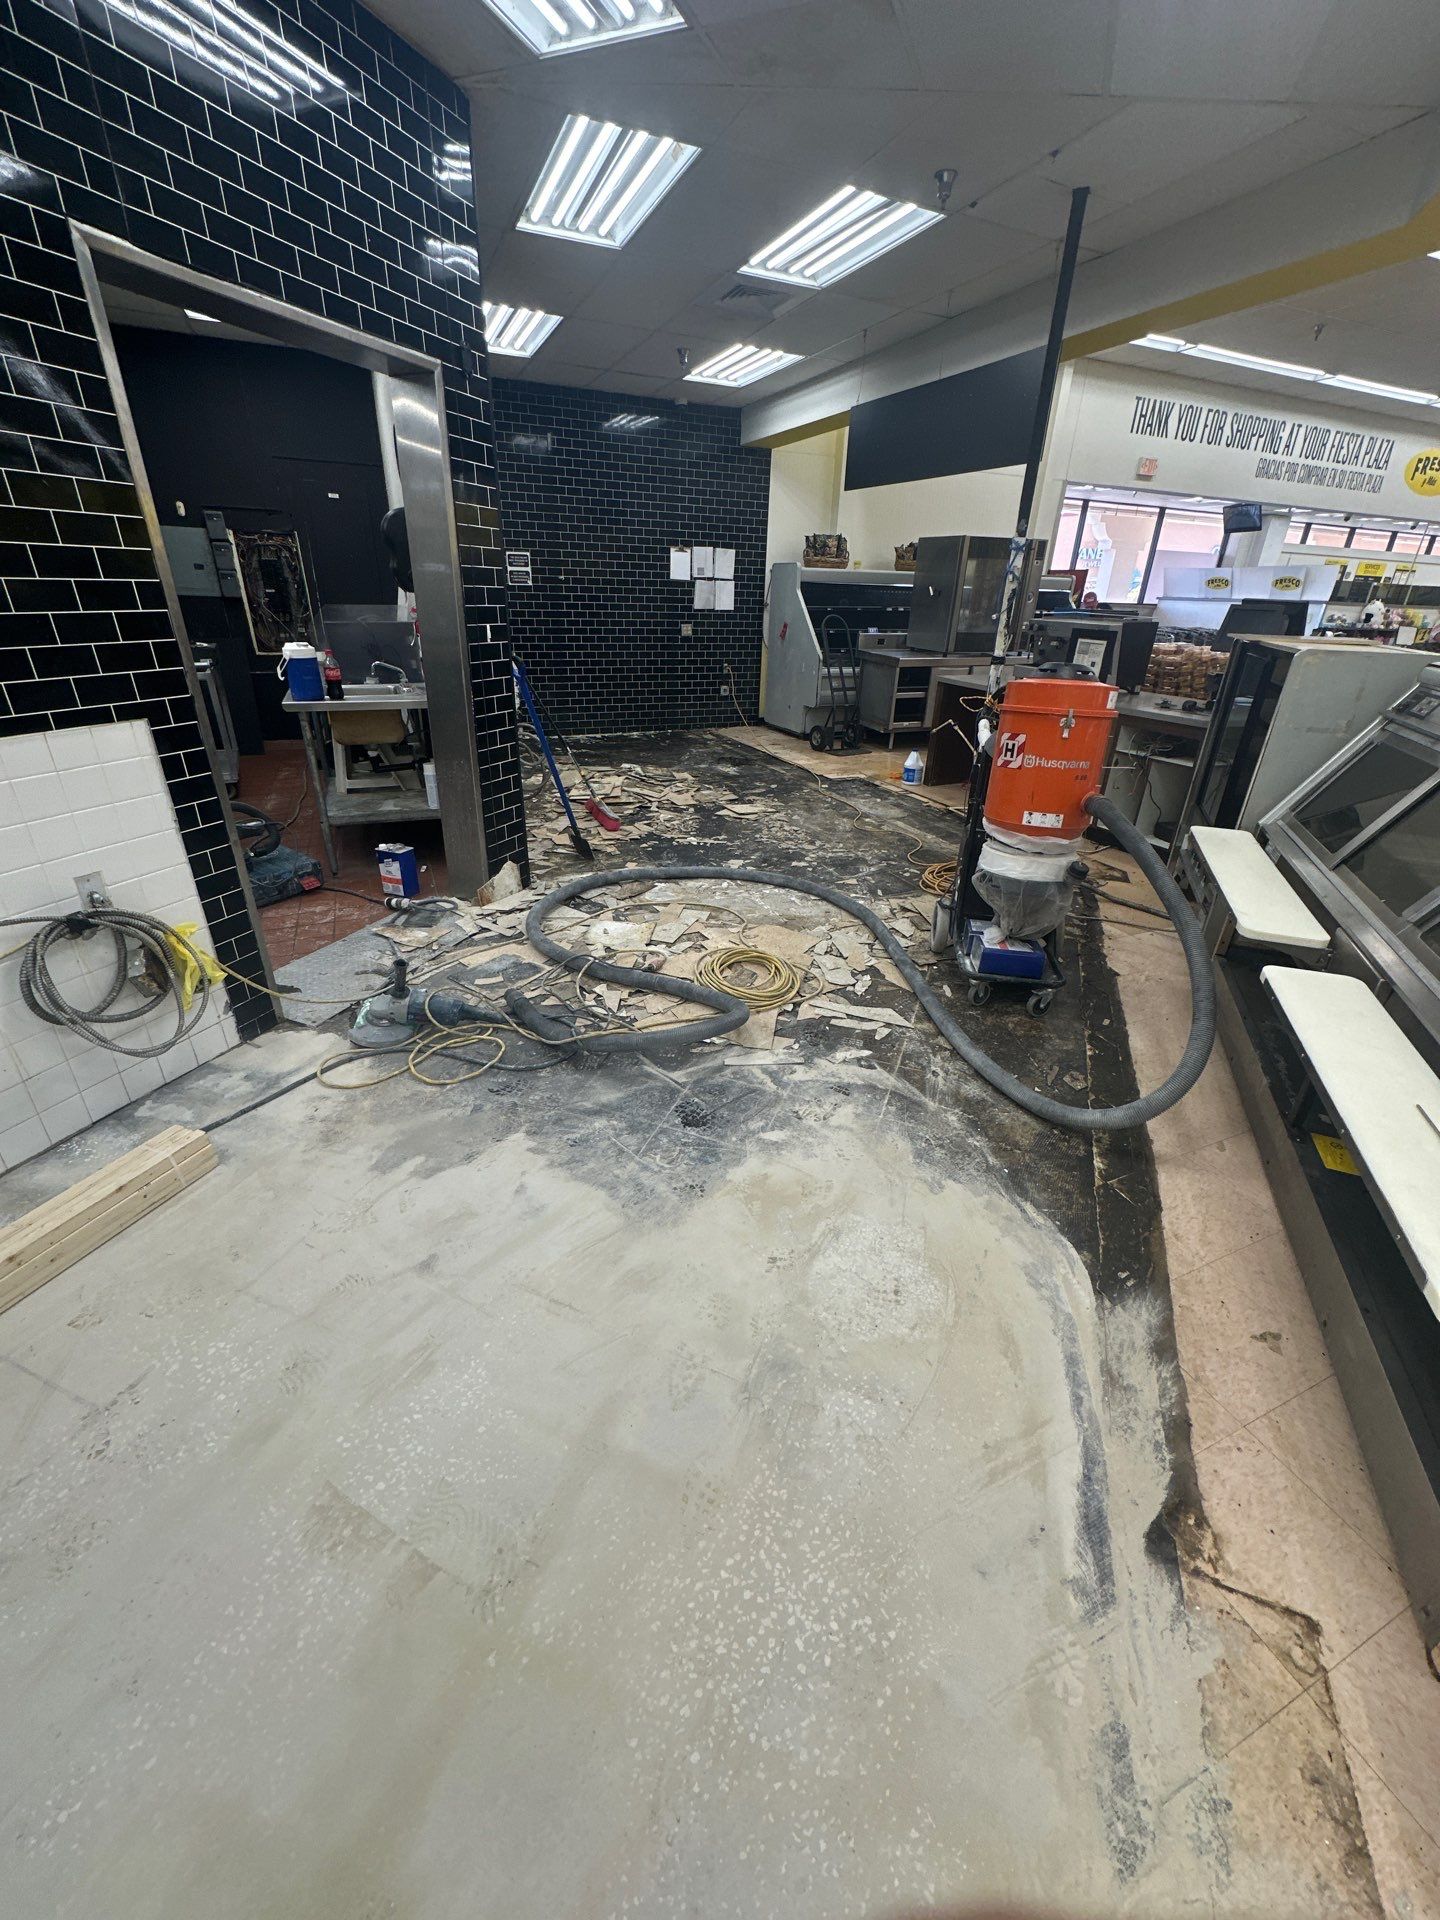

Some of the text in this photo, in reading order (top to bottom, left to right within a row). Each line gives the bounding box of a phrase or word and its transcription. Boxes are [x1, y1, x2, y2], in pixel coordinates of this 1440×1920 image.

[1130, 396, 1395, 471] THANK YOU FOR SHOPPING AT YOUR FIESTA PLAZA
[1255, 457, 1384, 494] GRACIAS POR COMPRAR EN SU FIESTA PLAZA
[1207, 578, 1229, 587] FRESCO
[1274, 577, 1301, 588] FRESCO
[1003, 742, 1016, 759] H
[1036, 756, 1090, 770] Husqvarna
